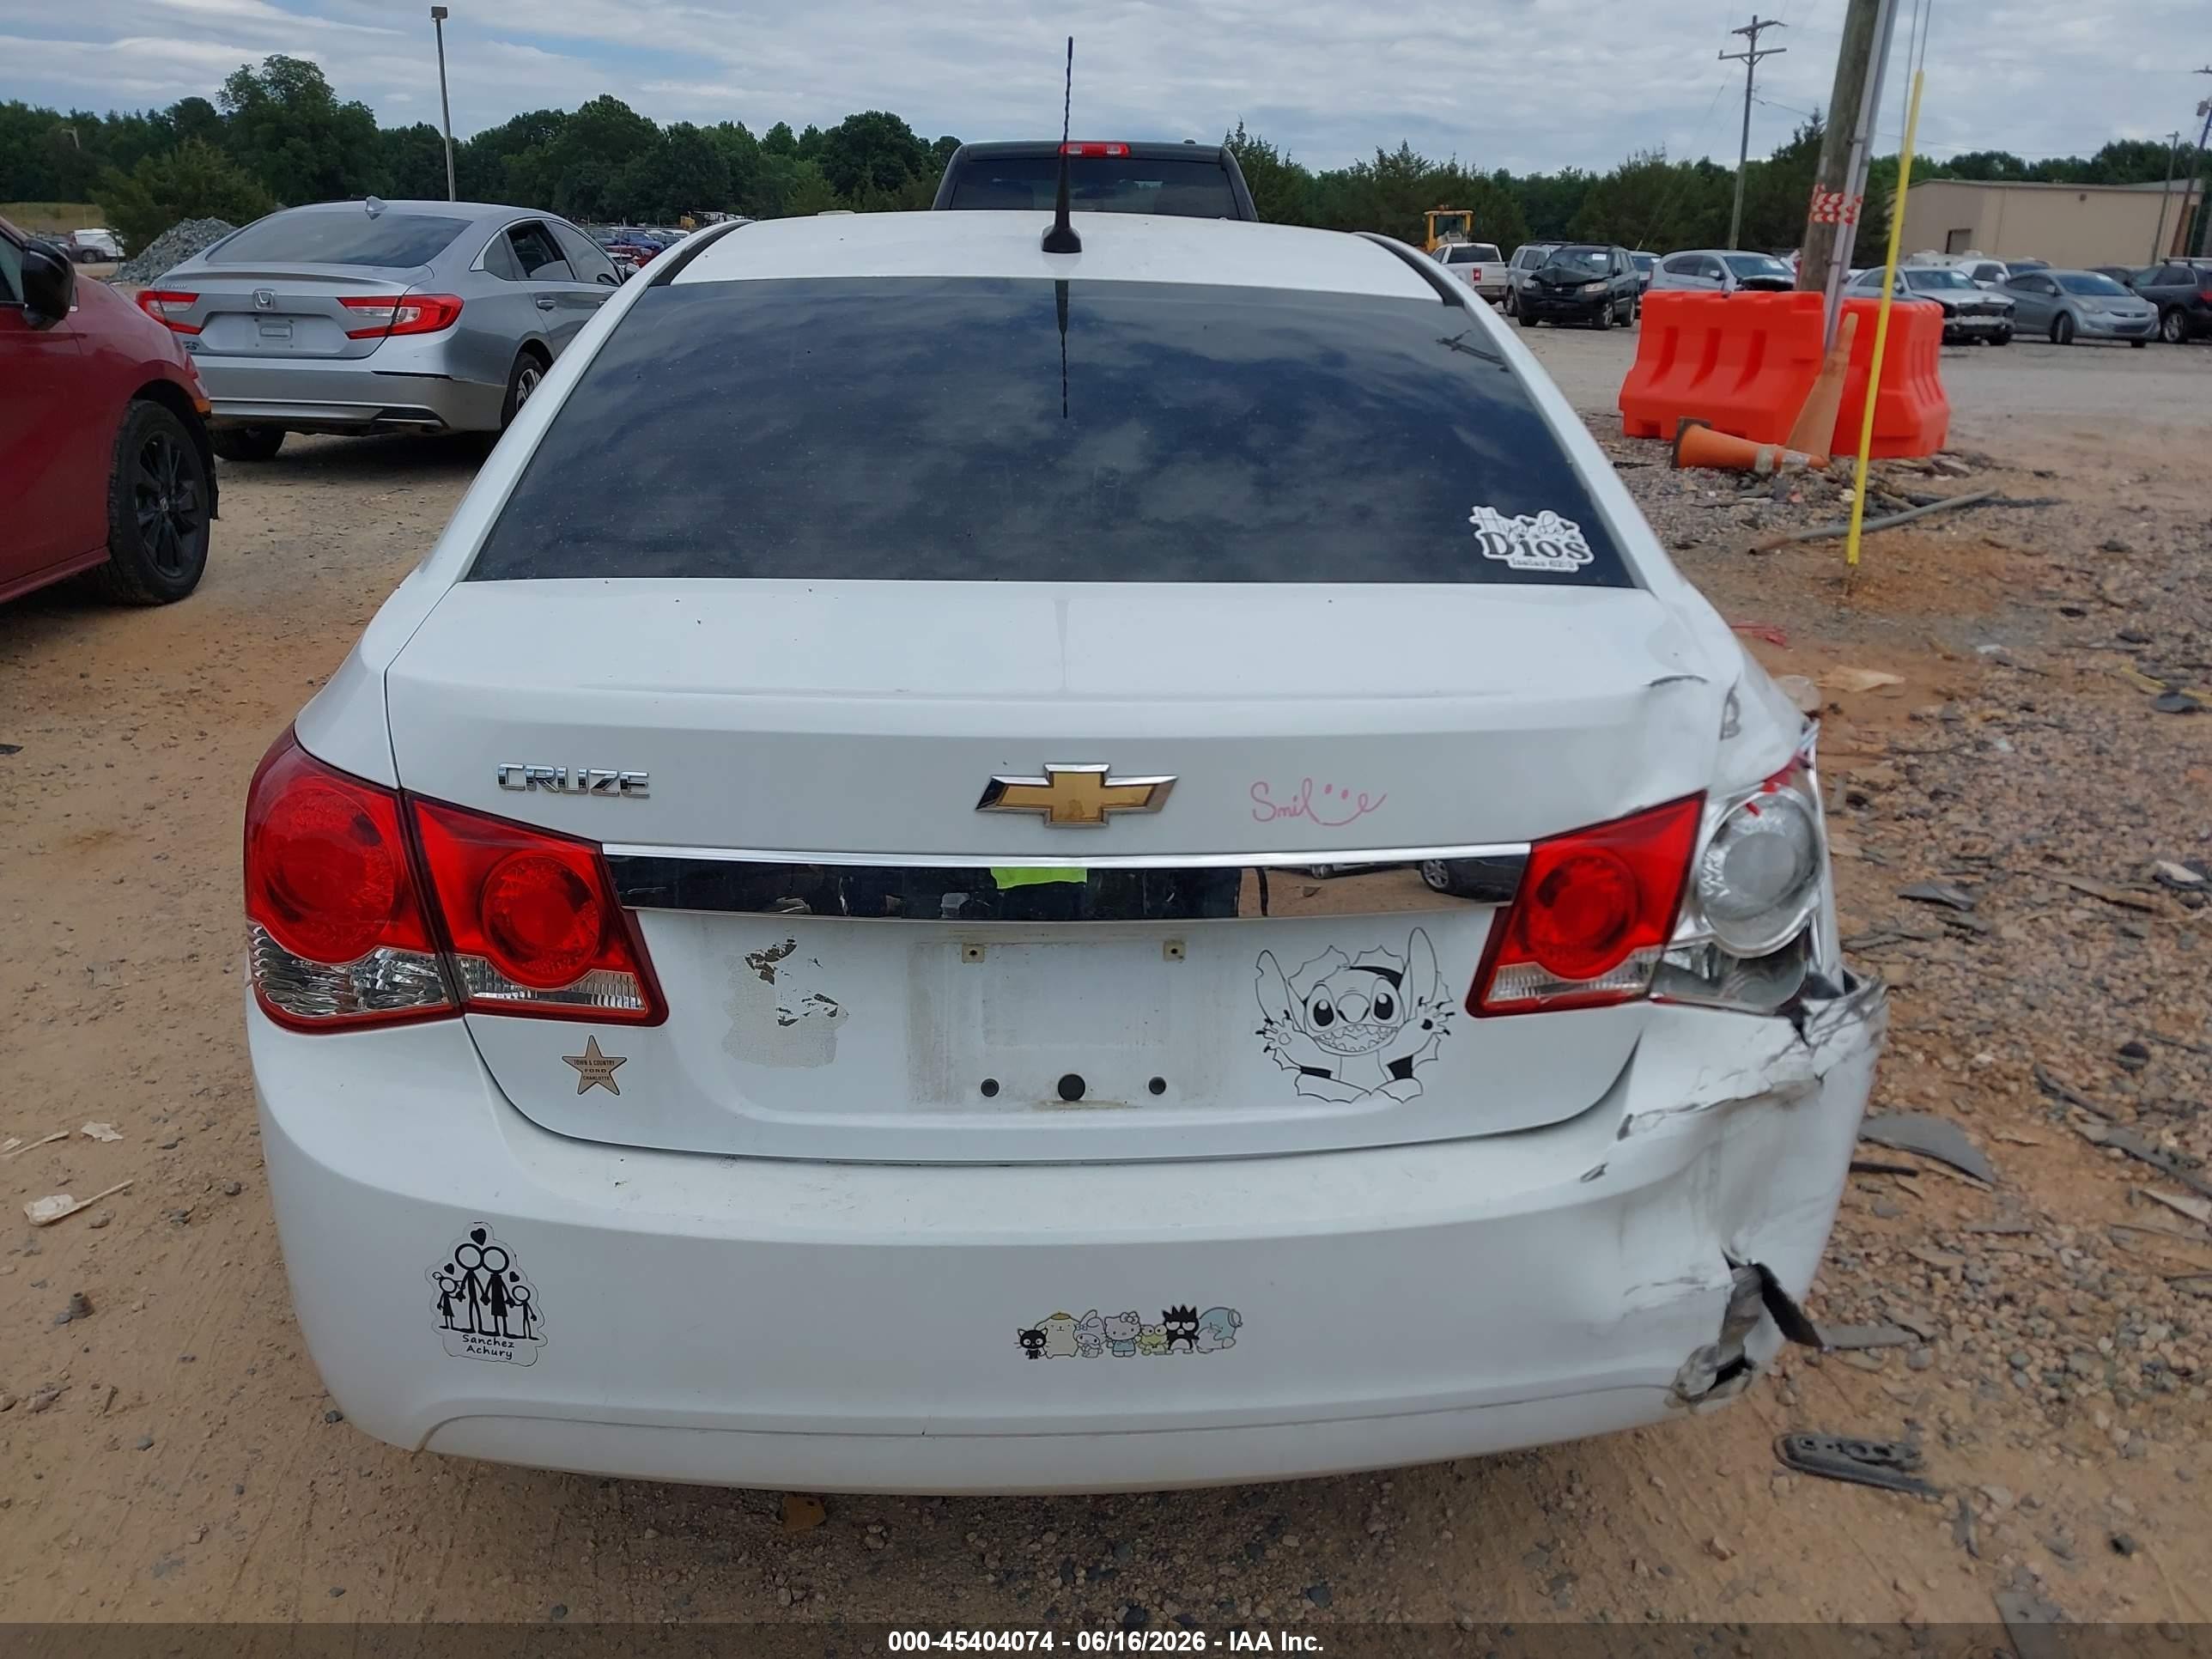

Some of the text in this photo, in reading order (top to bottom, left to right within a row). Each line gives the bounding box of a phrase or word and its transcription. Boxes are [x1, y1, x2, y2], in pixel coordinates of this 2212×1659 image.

[496, 762, 650, 799] CRUZE
[1250, 777, 1387, 826] Smile
[462, 1334, 515, 1348] Sanchez
[466, 1345, 513, 1360] Achury
